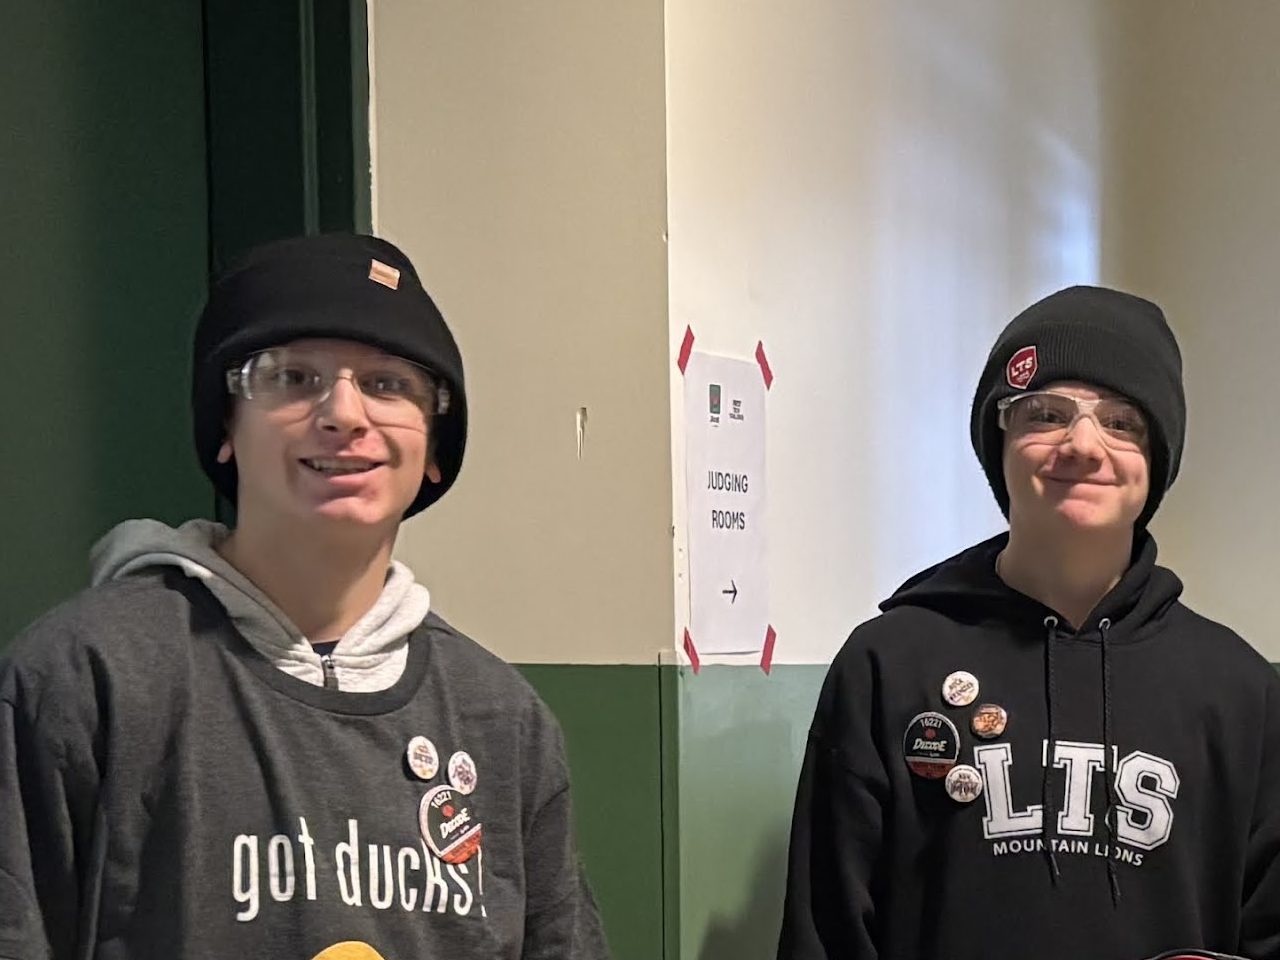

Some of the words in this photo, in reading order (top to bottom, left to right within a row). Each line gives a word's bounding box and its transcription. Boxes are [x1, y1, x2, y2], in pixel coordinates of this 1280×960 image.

[1011, 356, 1033, 377] LTS
[707, 469, 749, 493] JUDGING
[711, 509, 746, 530] ROOMS
[919, 716, 943, 729] 16221
[973, 738, 1181, 851] LTS
[992, 838, 1089, 856] MOUNTAIN
[232, 816, 317, 922] got
